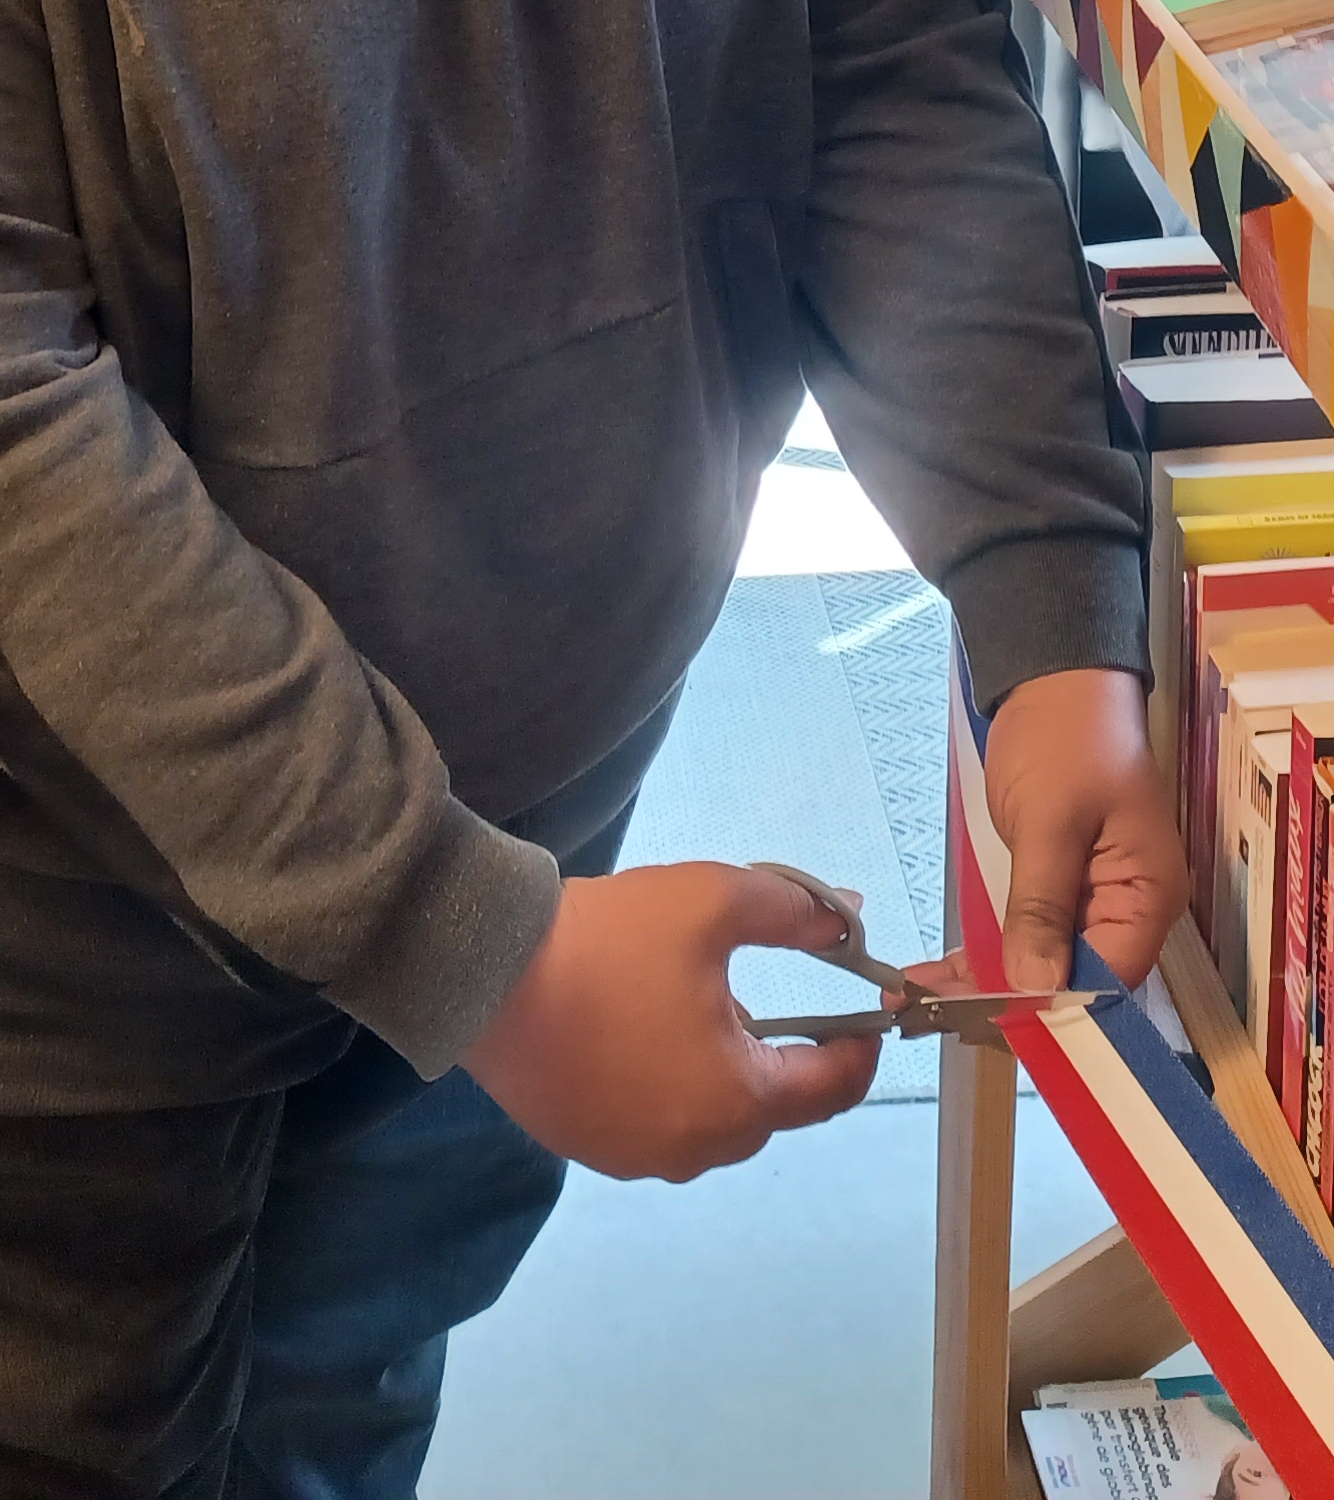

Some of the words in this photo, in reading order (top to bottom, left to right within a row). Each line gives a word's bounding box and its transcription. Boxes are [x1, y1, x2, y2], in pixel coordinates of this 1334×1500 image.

[1096, 1446, 1112, 1463] de
[1098, 1409, 1118, 1430] par
[1111, 1434, 1139, 1493] transfert
[1156, 1463, 1173, 1489] des
